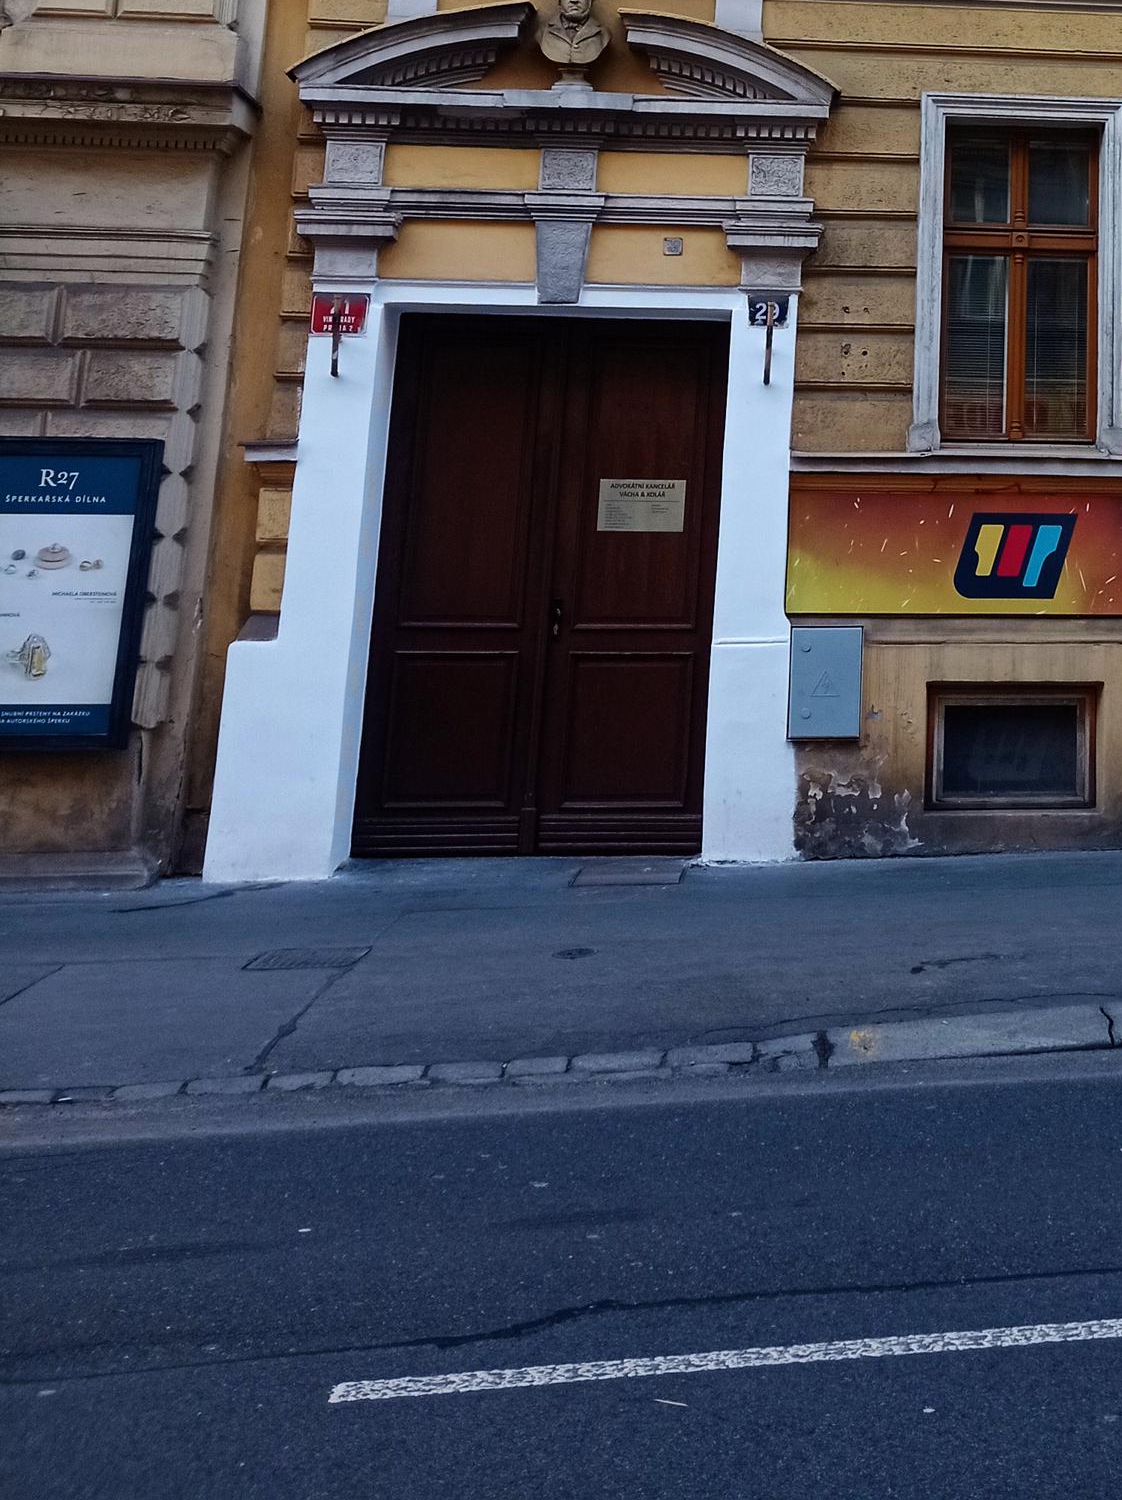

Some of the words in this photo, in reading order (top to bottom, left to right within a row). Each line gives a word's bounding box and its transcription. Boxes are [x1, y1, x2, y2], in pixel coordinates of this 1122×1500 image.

[755, 302, 780, 320] 29
[323, 315, 356, 323] VINRADY
[38, 468, 80, 490] R27
[75, 494, 106, 503] DÍLNA
